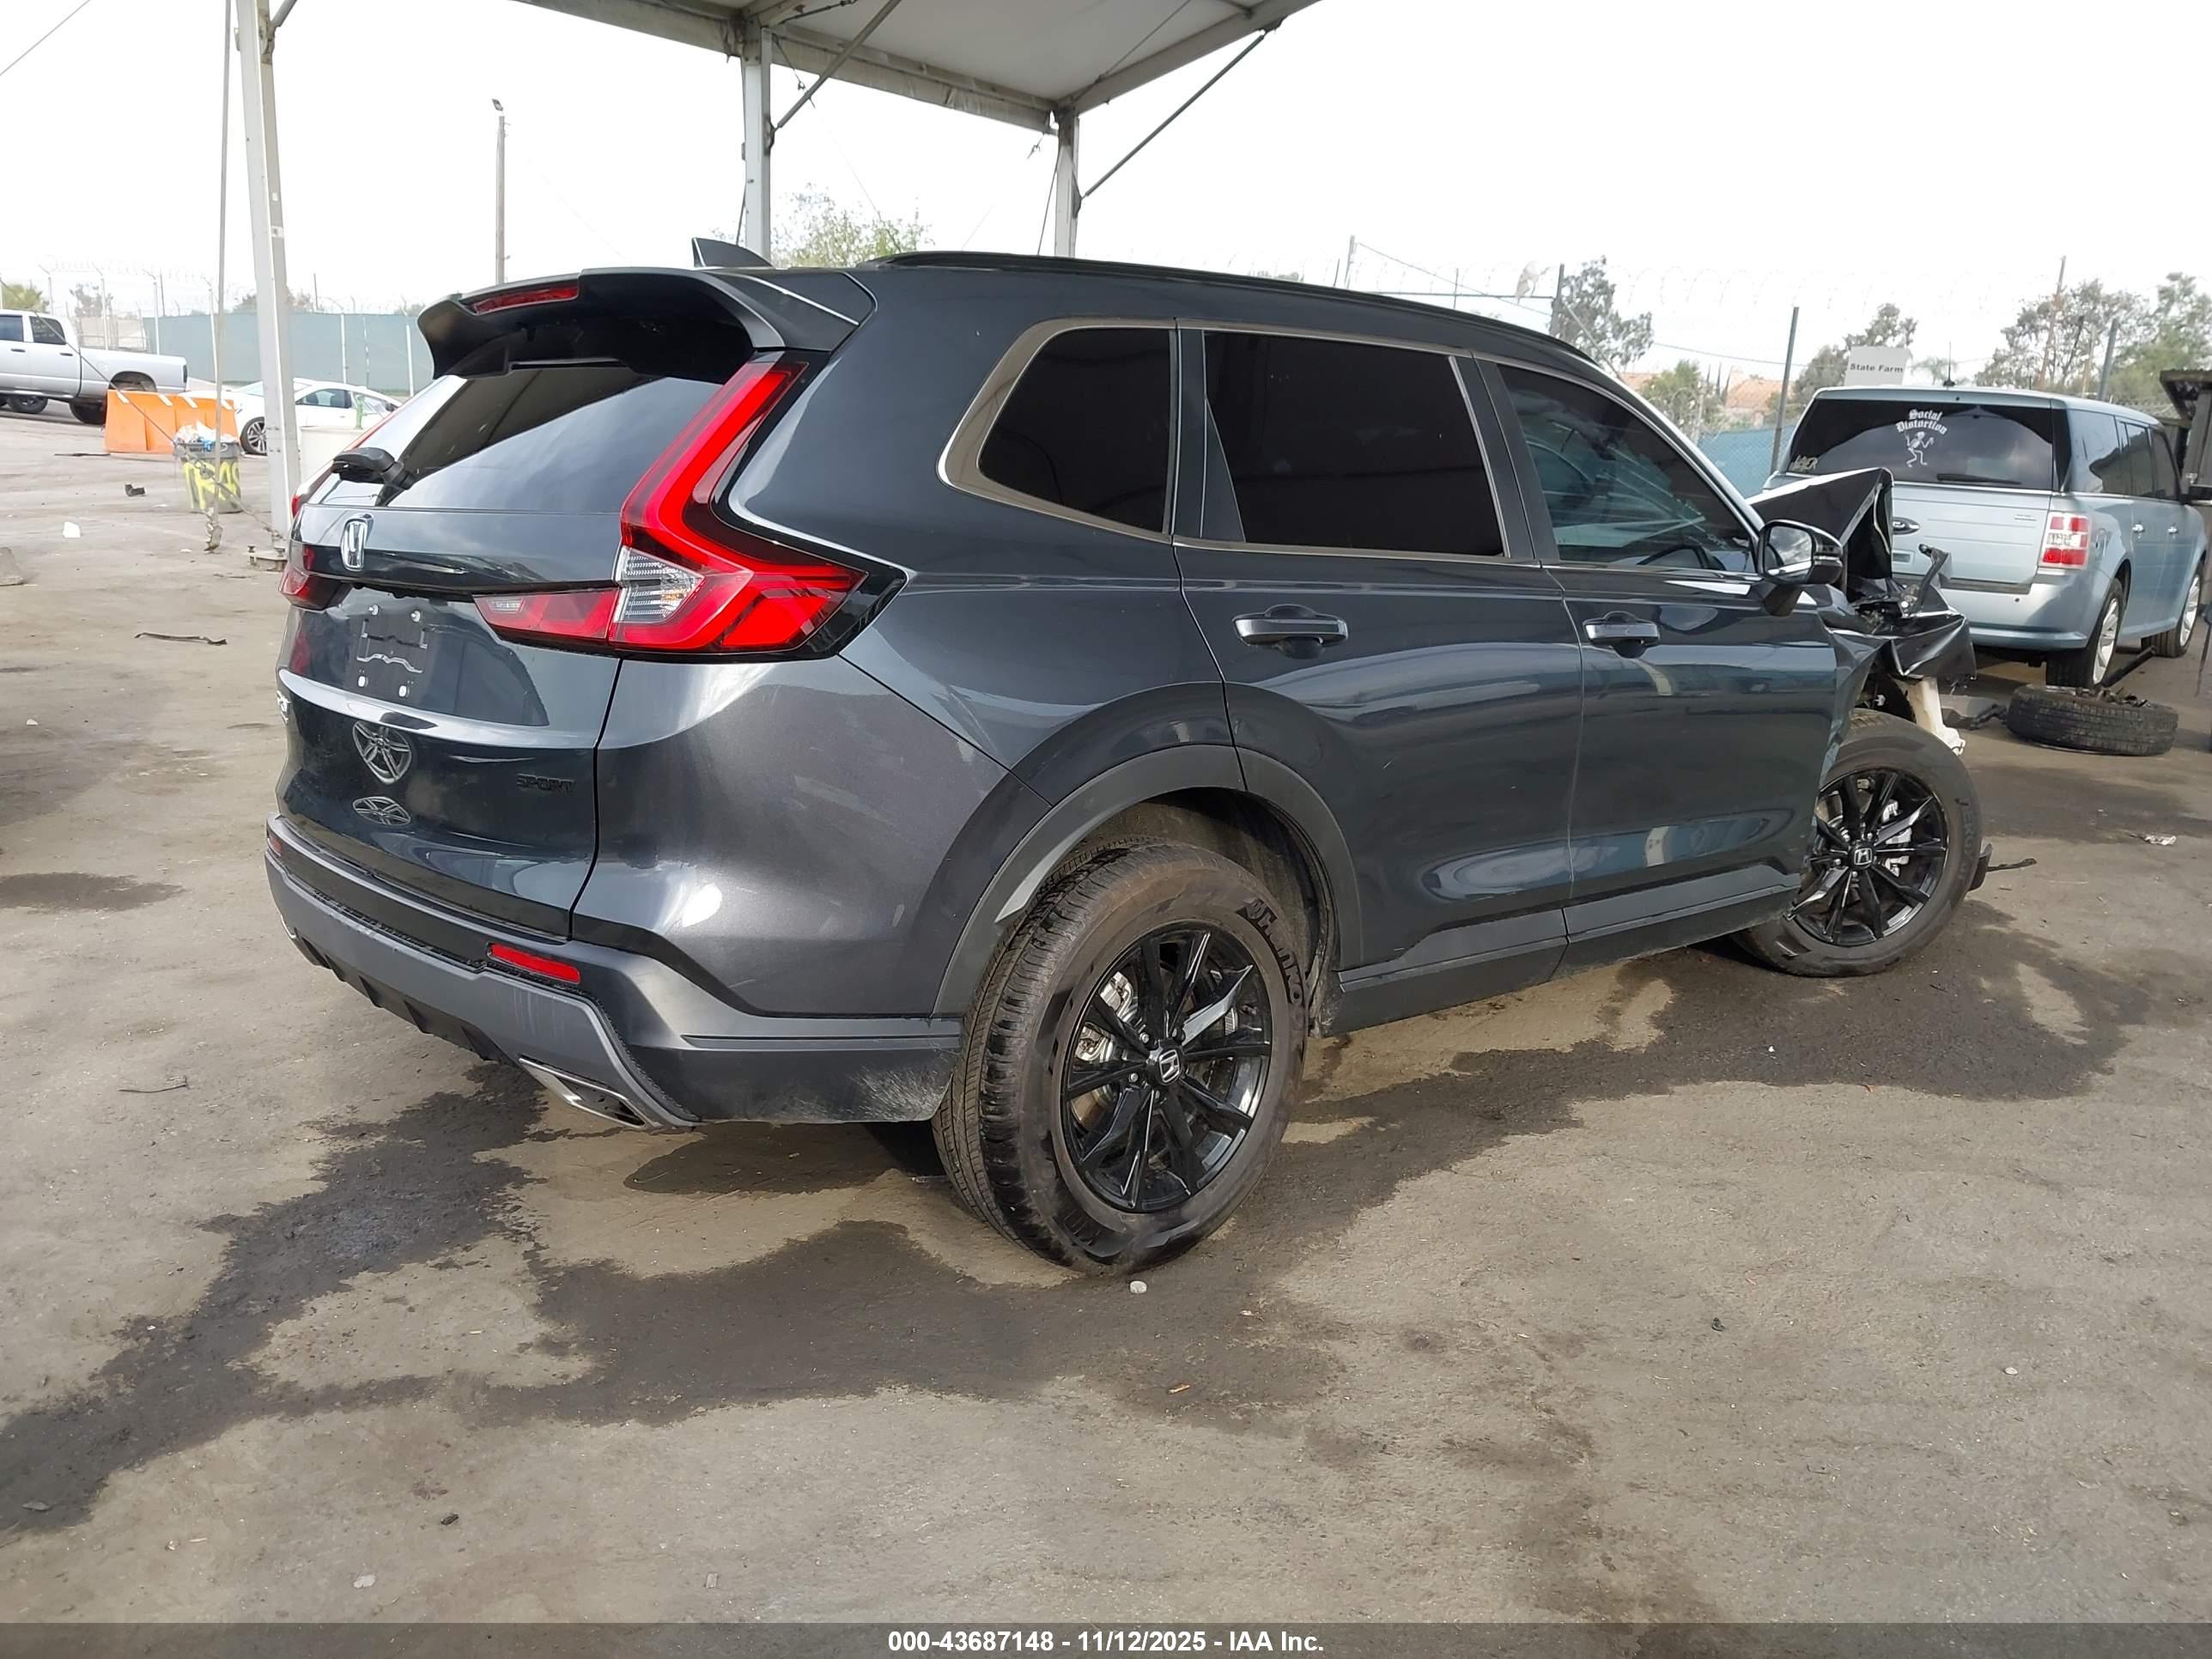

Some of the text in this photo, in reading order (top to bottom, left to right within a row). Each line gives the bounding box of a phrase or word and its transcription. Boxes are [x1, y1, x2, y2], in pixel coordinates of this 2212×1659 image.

[1850, 363, 1904, 373] State Farm
[1908, 409, 1942, 421] Social
[1896, 419, 1948, 434] Distortion
[516, 773, 574, 794] SPORT
